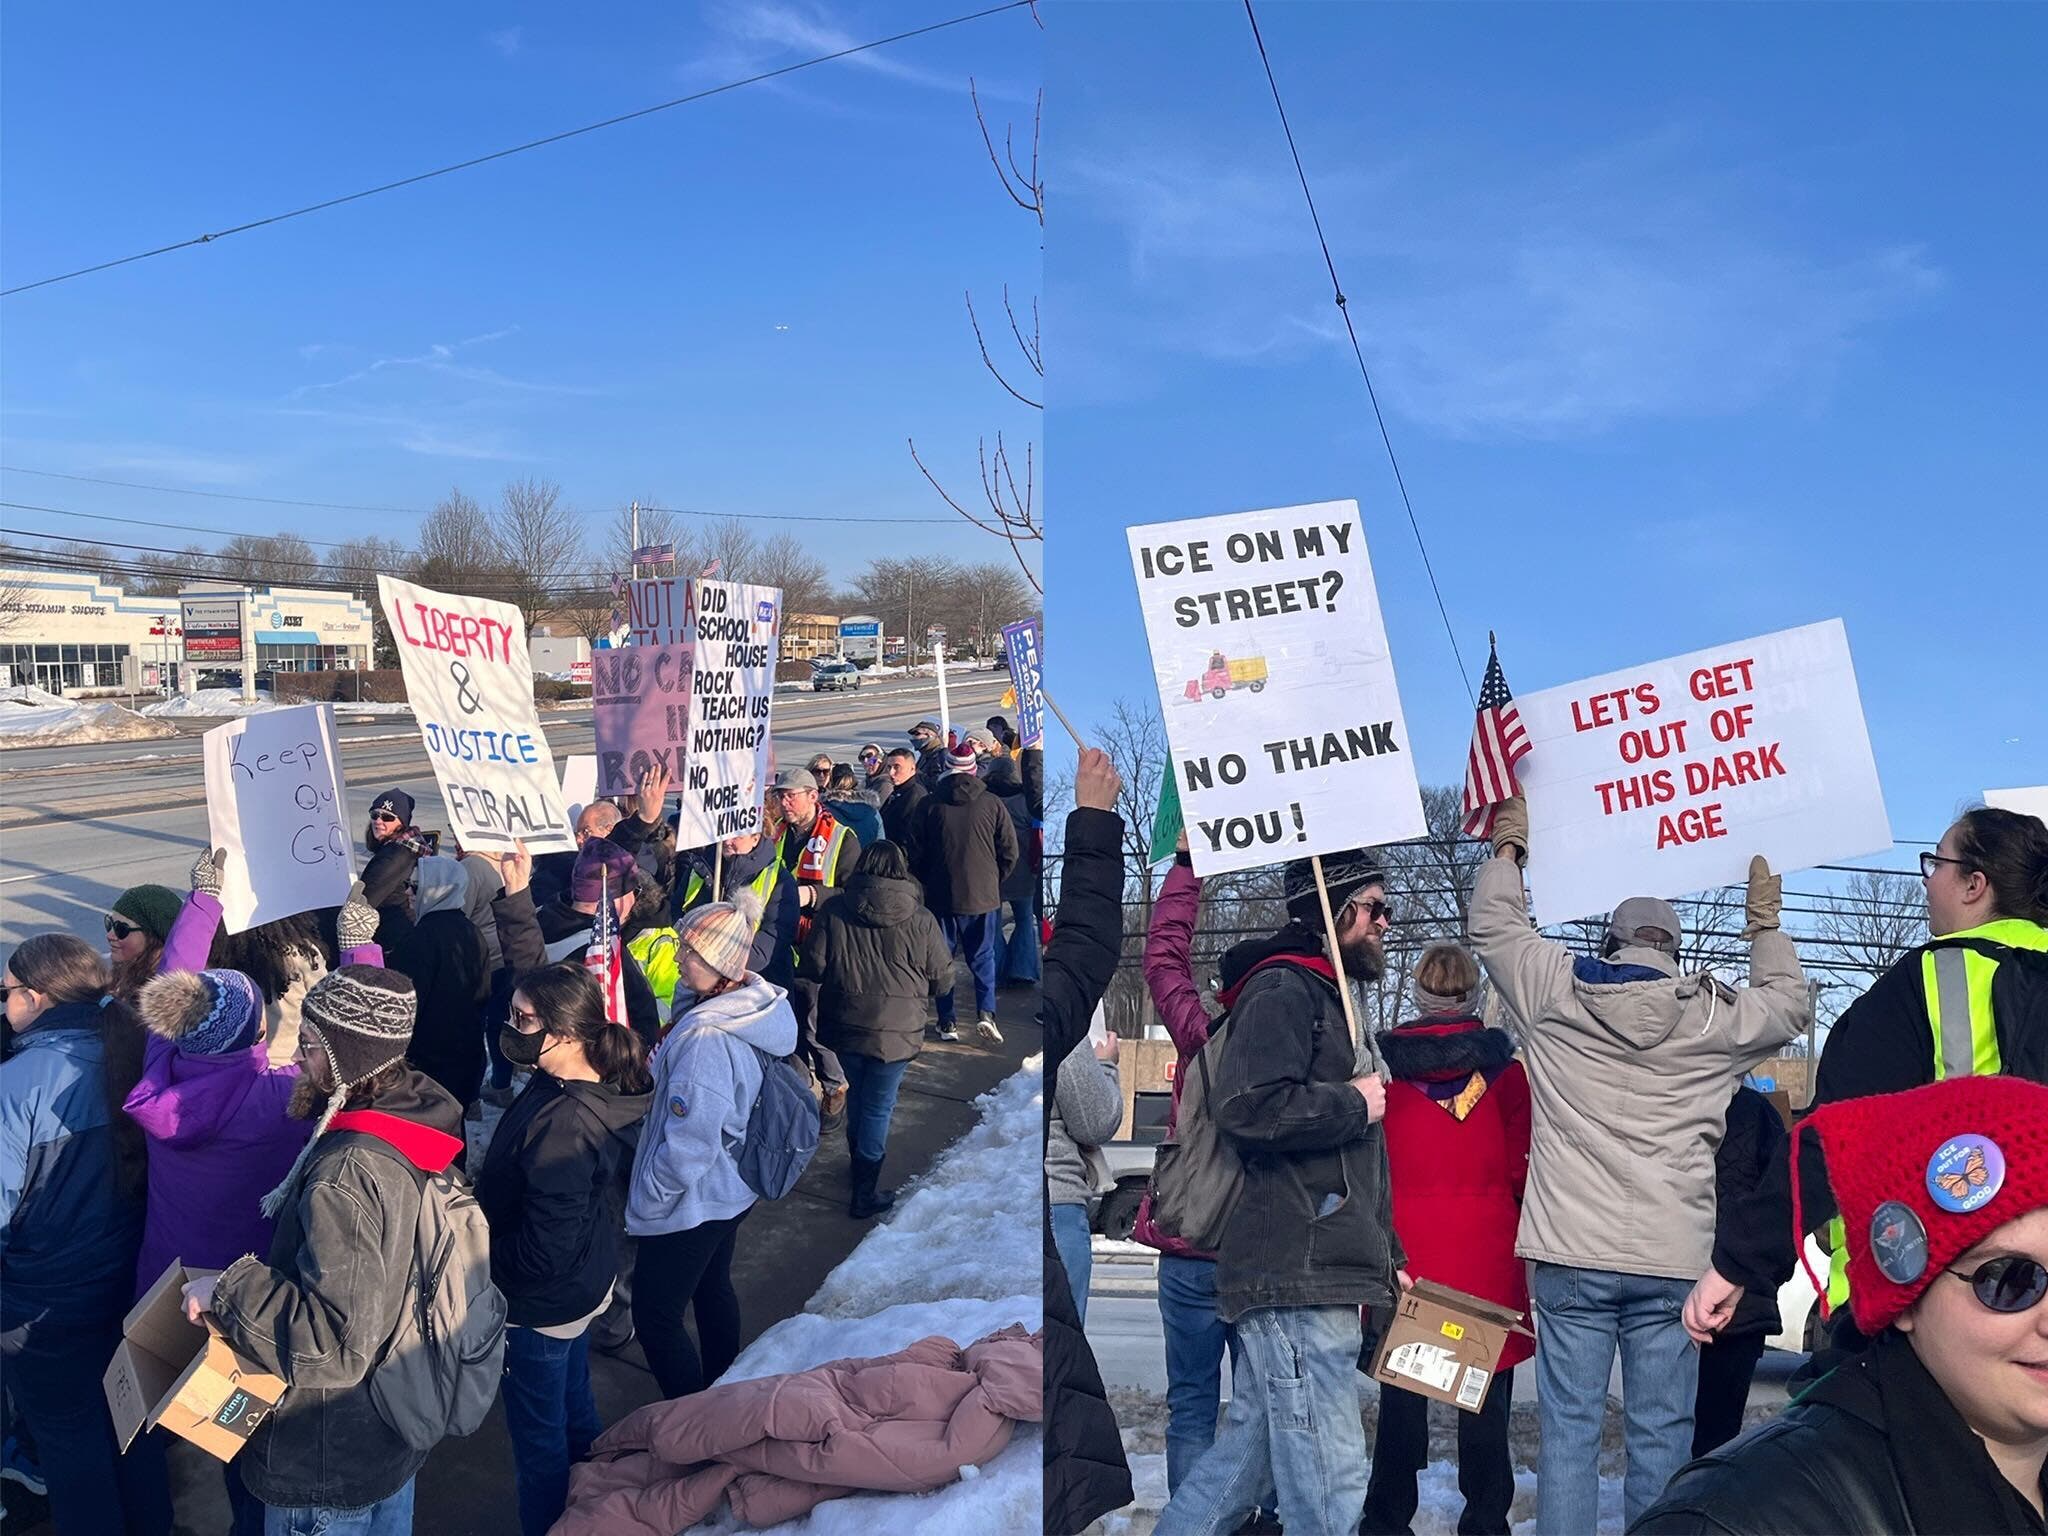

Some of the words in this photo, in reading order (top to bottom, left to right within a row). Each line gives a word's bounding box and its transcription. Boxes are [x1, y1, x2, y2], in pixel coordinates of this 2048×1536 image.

[1140, 541, 1213, 579] ICE
[1227, 531, 1283, 563] ON
[1293, 522, 1352, 560] MY
[627, 580, 674, 628] NOT
[683, 579, 697, 627] A
[701, 587, 727, 612] DID
[1175, 571, 1344, 627] STREET?
[395, 599, 515, 665] LIBERTY
[698, 616, 750, 643] SCHOOL
[594, 654, 642, 696] NO
[725, 644, 768, 667] HOUSE
[450, 661, 484, 714] &
[694, 671, 733, 694] ROCK
[1023, 628, 1043, 730] PEACE
[1571, 682, 1660, 732] LET'S
[1689, 659, 1755, 701] GET
[702, 697, 747, 721] TEACH
[751, 698, 769, 719] US
[425, 723, 538, 764] JUSTICE
[694, 724, 765, 754] NOTHING?
[1619, 720, 1687, 764] OUT
[1710, 704, 1754, 742] OF
[226, 734, 318, 782] Keep
[1184, 754, 1247, 791] NO
[1264, 721, 1400, 774] THANK
[689, 767, 708, 790] NO
[703, 784, 738, 812] MORE
[1594, 770, 1675, 815] THIS
[1684, 742, 1787, 796] DARK
[446, 783, 506, 828] FOR
[505, 792, 564, 831] ALL
[717, 805, 762, 836] KINGS!
[1198, 802, 1307, 853] YOU!
[1657, 803, 1727, 850] AGE
[1937, 1159, 1953, 1173] OUT
[1953, 1147, 1971, 1161] FOR
[1938, 1144, 1958, 1160] ICE
[1962, 1185, 1992, 1209] GOOD
[219, 1393, 243, 1424] prime
